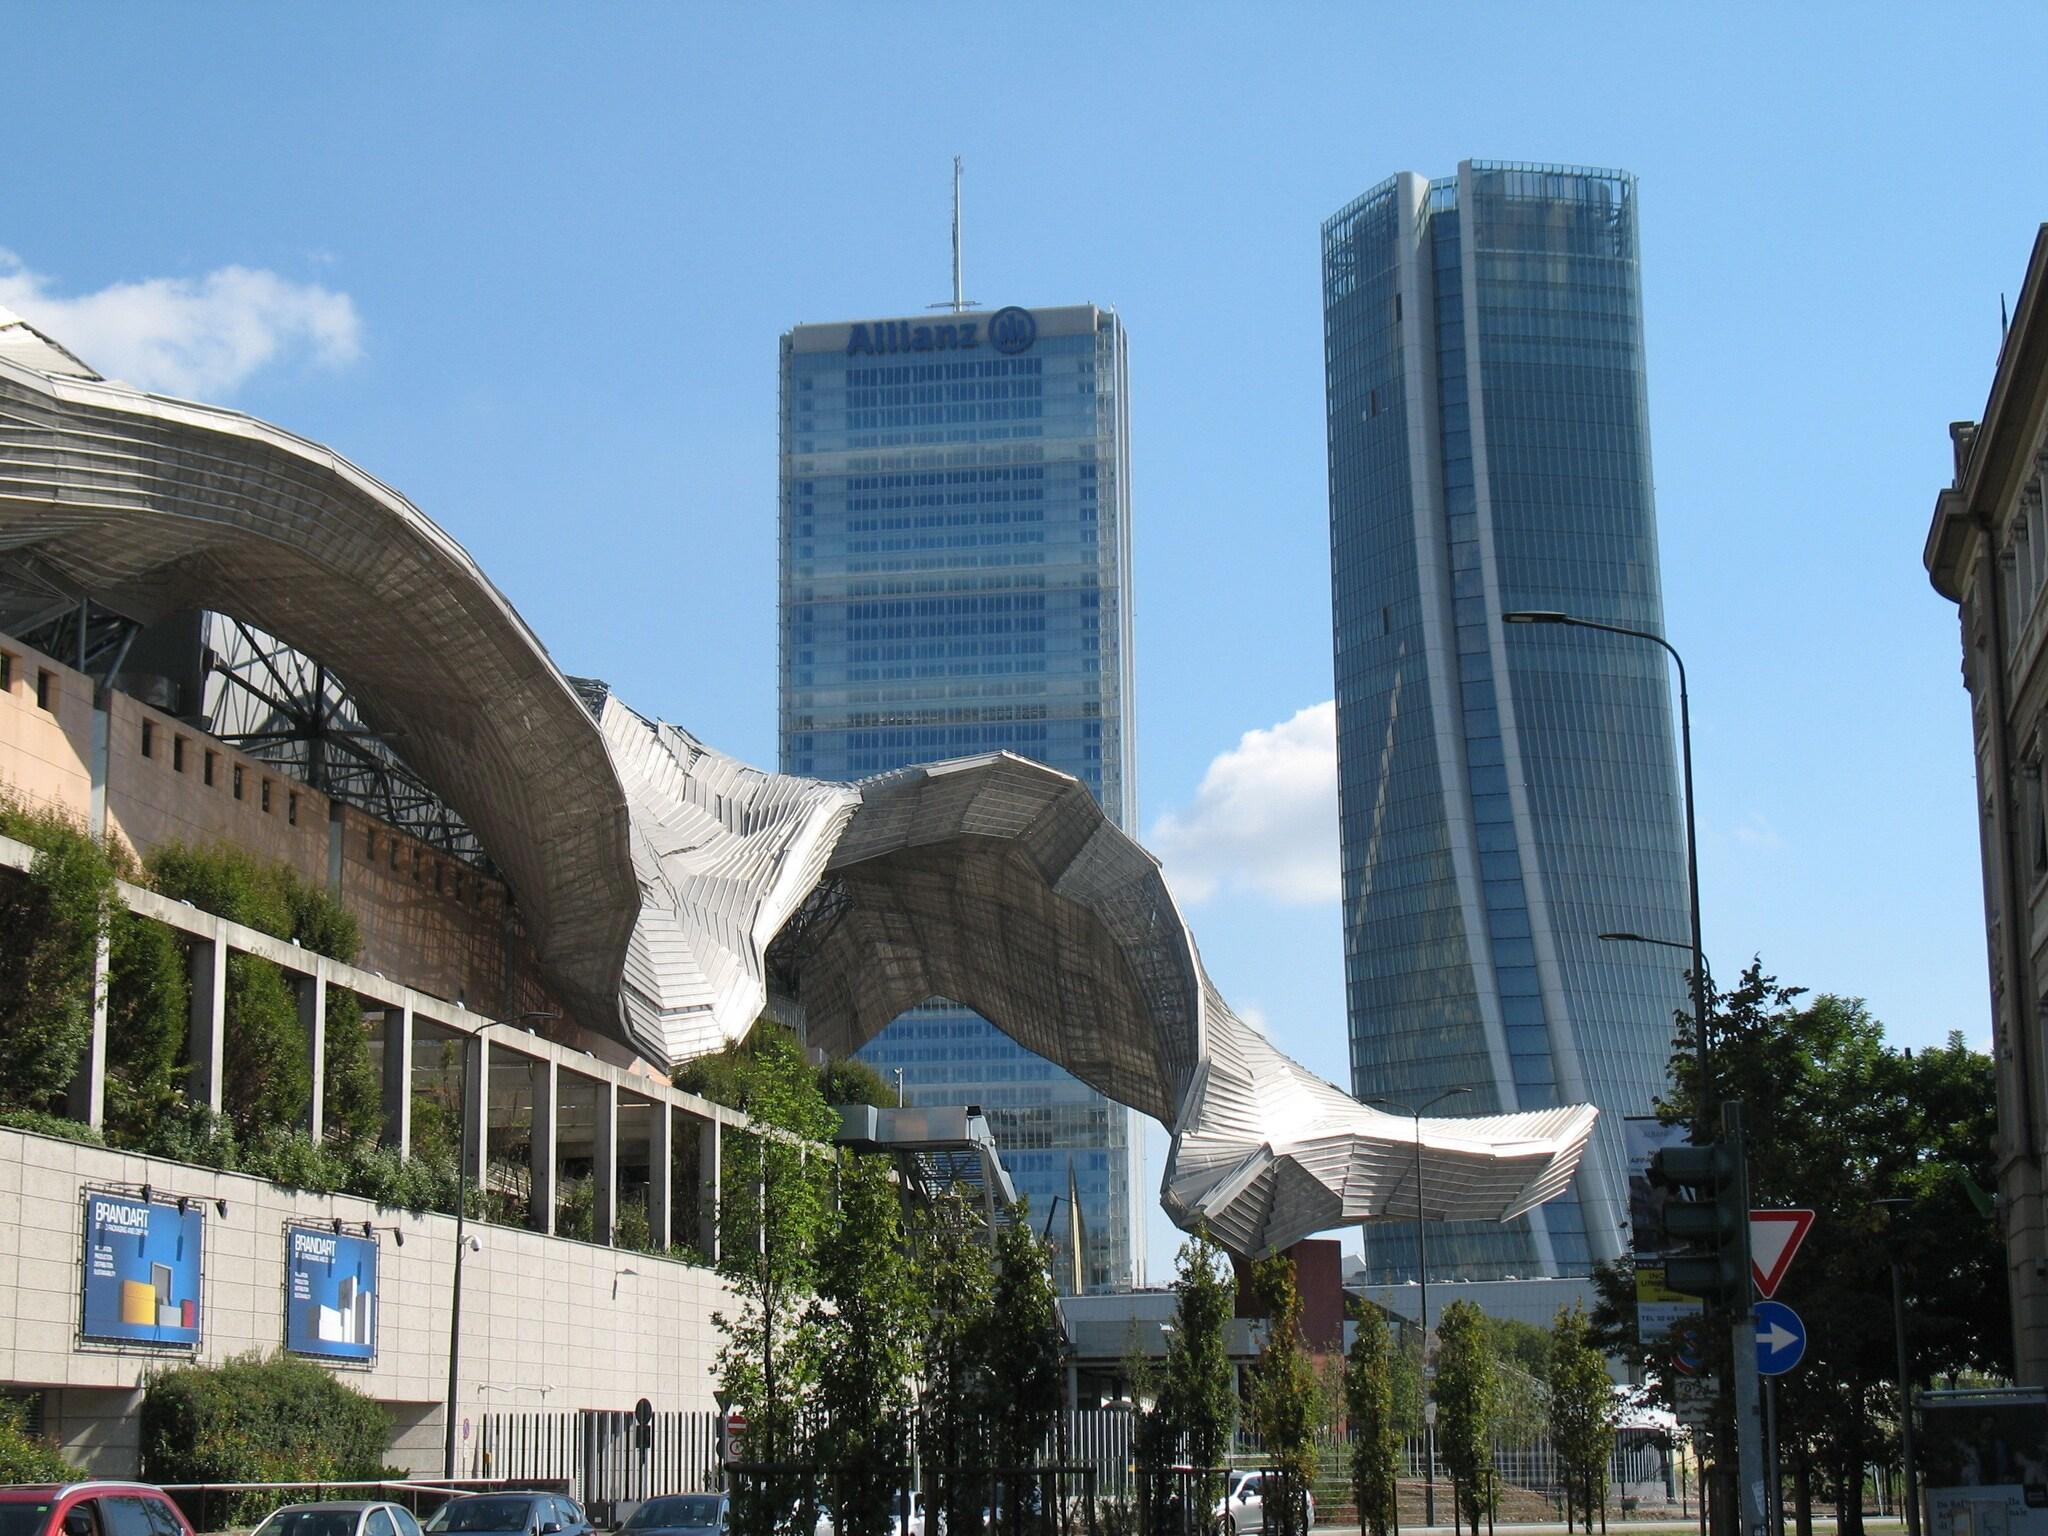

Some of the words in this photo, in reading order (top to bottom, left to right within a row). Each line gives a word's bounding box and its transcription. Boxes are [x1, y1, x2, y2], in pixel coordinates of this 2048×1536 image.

[847, 321, 980, 356] Allianz
[95, 1202, 150, 1227] BRANDART
[295, 1234, 337, 1257] BRANDART
